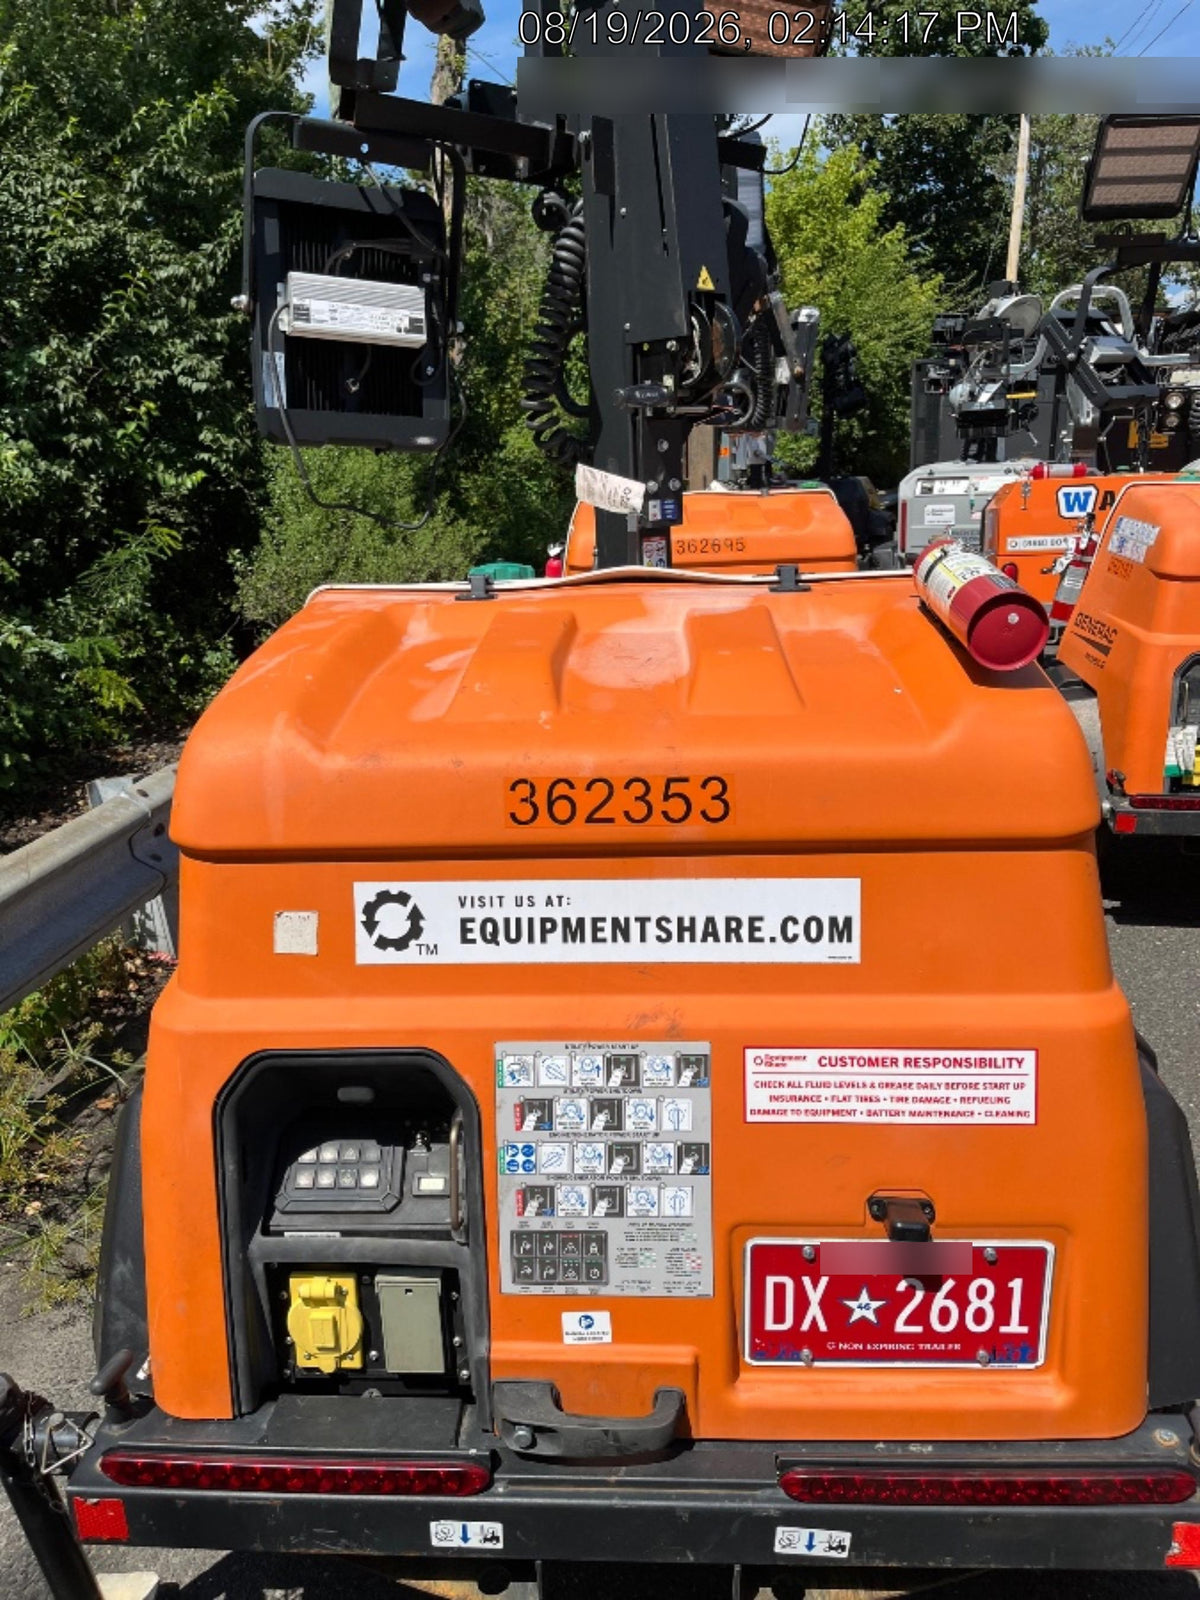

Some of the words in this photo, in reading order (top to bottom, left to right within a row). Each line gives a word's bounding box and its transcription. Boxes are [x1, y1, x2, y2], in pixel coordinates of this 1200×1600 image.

[676, 537, 746, 555] 362695
[509, 776, 731, 826] 362353
[458, 896, 504, 909] VISIT
[514, 895, 536, 908] US
[544, 895, 572, 908] AT:
[459, 915, 854, 947] EQUIPMENTSHARE.COM
[416, 943, 438, 956] TM
[817, 1055, 899, 1069] CUSTOMER
[903, 1056, 1025, 1069] RESPONSIBILITY
[753, 1080, 785, 1090] CHECK
[786, 1080, 803, 1090] ALL
[805, 1081, 832, 1090] FLUID
[833, 1081, 867, 1090] LEVELS
[877, 1081, 914, 1091] GREASE
[916, 1081, 943, 1091] DAILY
[944, 1082, 980, 1091] BEFORE
[982, 1082, 1011, 1091] START
[1013, 1082, 1026, 1091] UP
[769, 1094, 822, 1104] INSURANCE
[830, 1095, 853, 1104] FLAT
[854, 1095, 881, 1104] TIRES
[911, 1096, 952, 1105] DAMAGE
[959, 1096, 1011, 1105] REFUELING
[749, 1108, 788, 1118] DAMAGE
[790, 1108, 801, 1118] TO
[804, 1108, 858, 1118] EQUIPMENT
[865, 1109, 906, 1118] BATTERY
[908, 1109, 975, 1118] MAINTENANCE
[984, 1109, 1031, 1119] CLEANING
[764, 1275, 829, 1332] DX
[893, 1277, 1030, 1334] 2681
[838, 1342, 863, 1351] NON
[866, 1342, 915, 1351] EXPIRING
[918, 1342, 961, 1351] TRAILER
